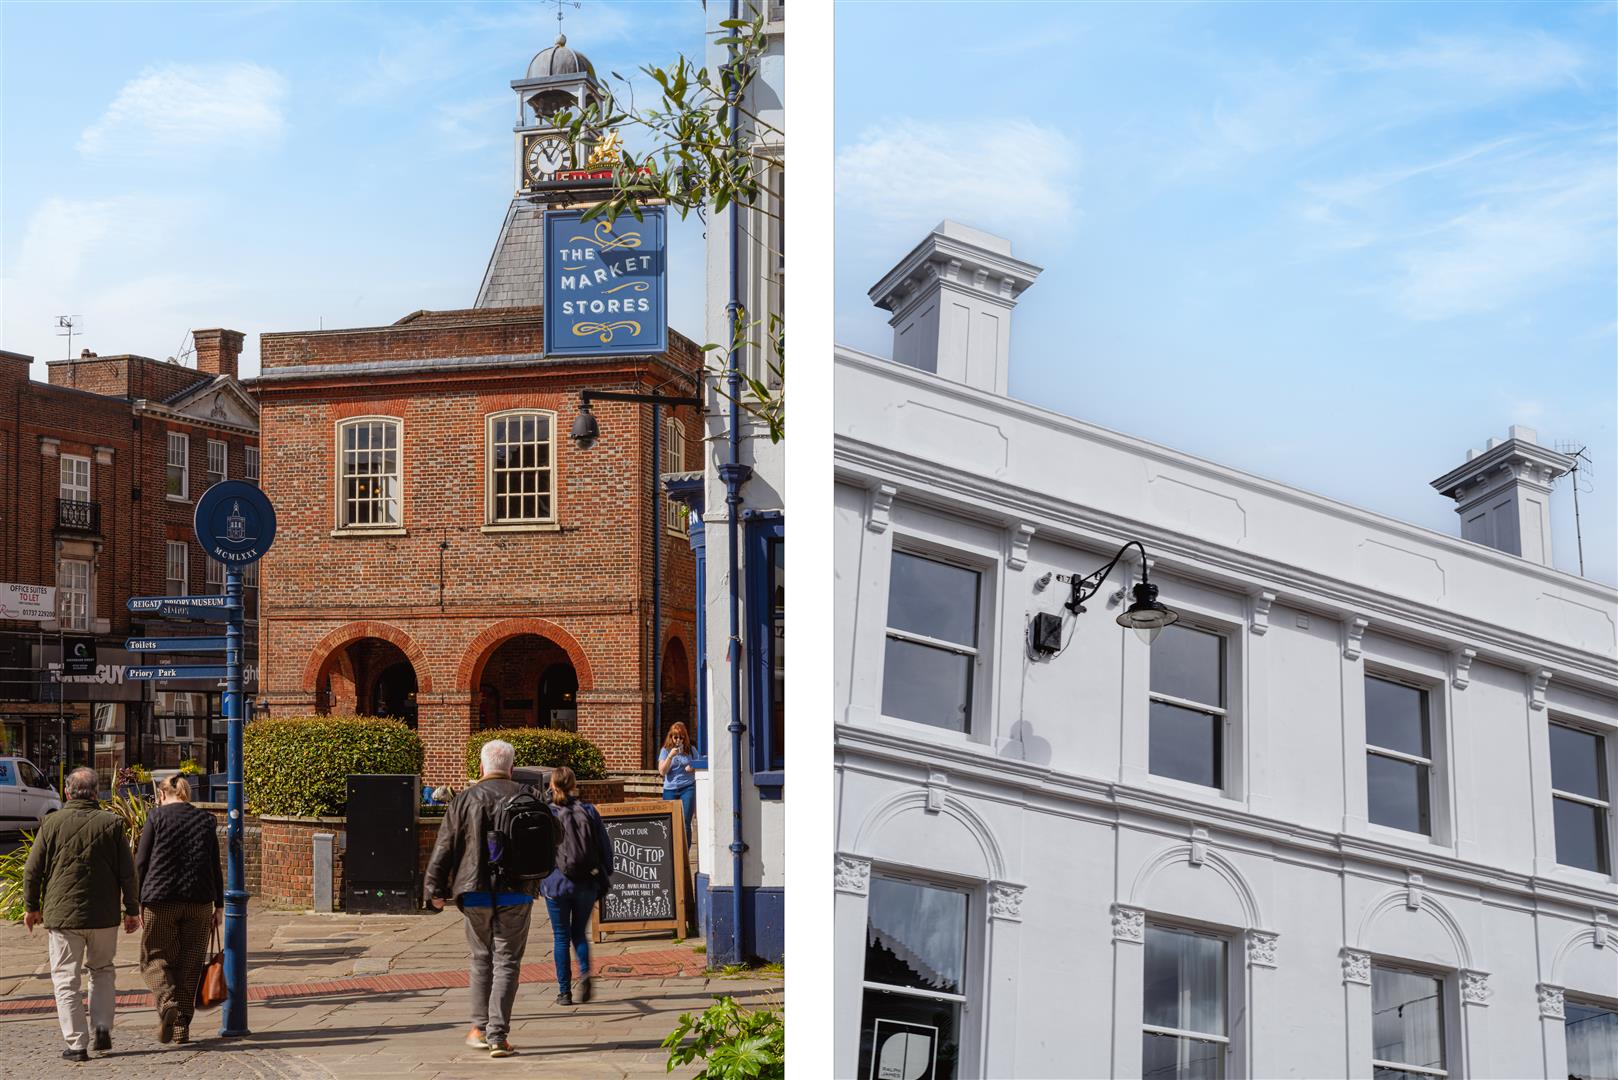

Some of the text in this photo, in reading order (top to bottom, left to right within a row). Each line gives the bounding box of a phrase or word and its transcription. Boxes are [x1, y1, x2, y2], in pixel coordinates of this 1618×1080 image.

[560, 248, 595, 261] THE
[561, 255, 651, 290] MARKET
[562, 298, 650, 315] STORES
[214, 546, 258, 561] MCMLXXX
[10, 585, 29, 593] OFFICE
[20, 593, 39, 602] TO LET
[133, 600, 161, 608] REIGAT
[191, 598, 224, 607] MUSEUM
[129, 641, 157, 649] Toilets
[129, 669, 177, 678] Priory Park
[620, 828, 636, 836] VISIT
[612, 855, 658, 880] GARDEN
